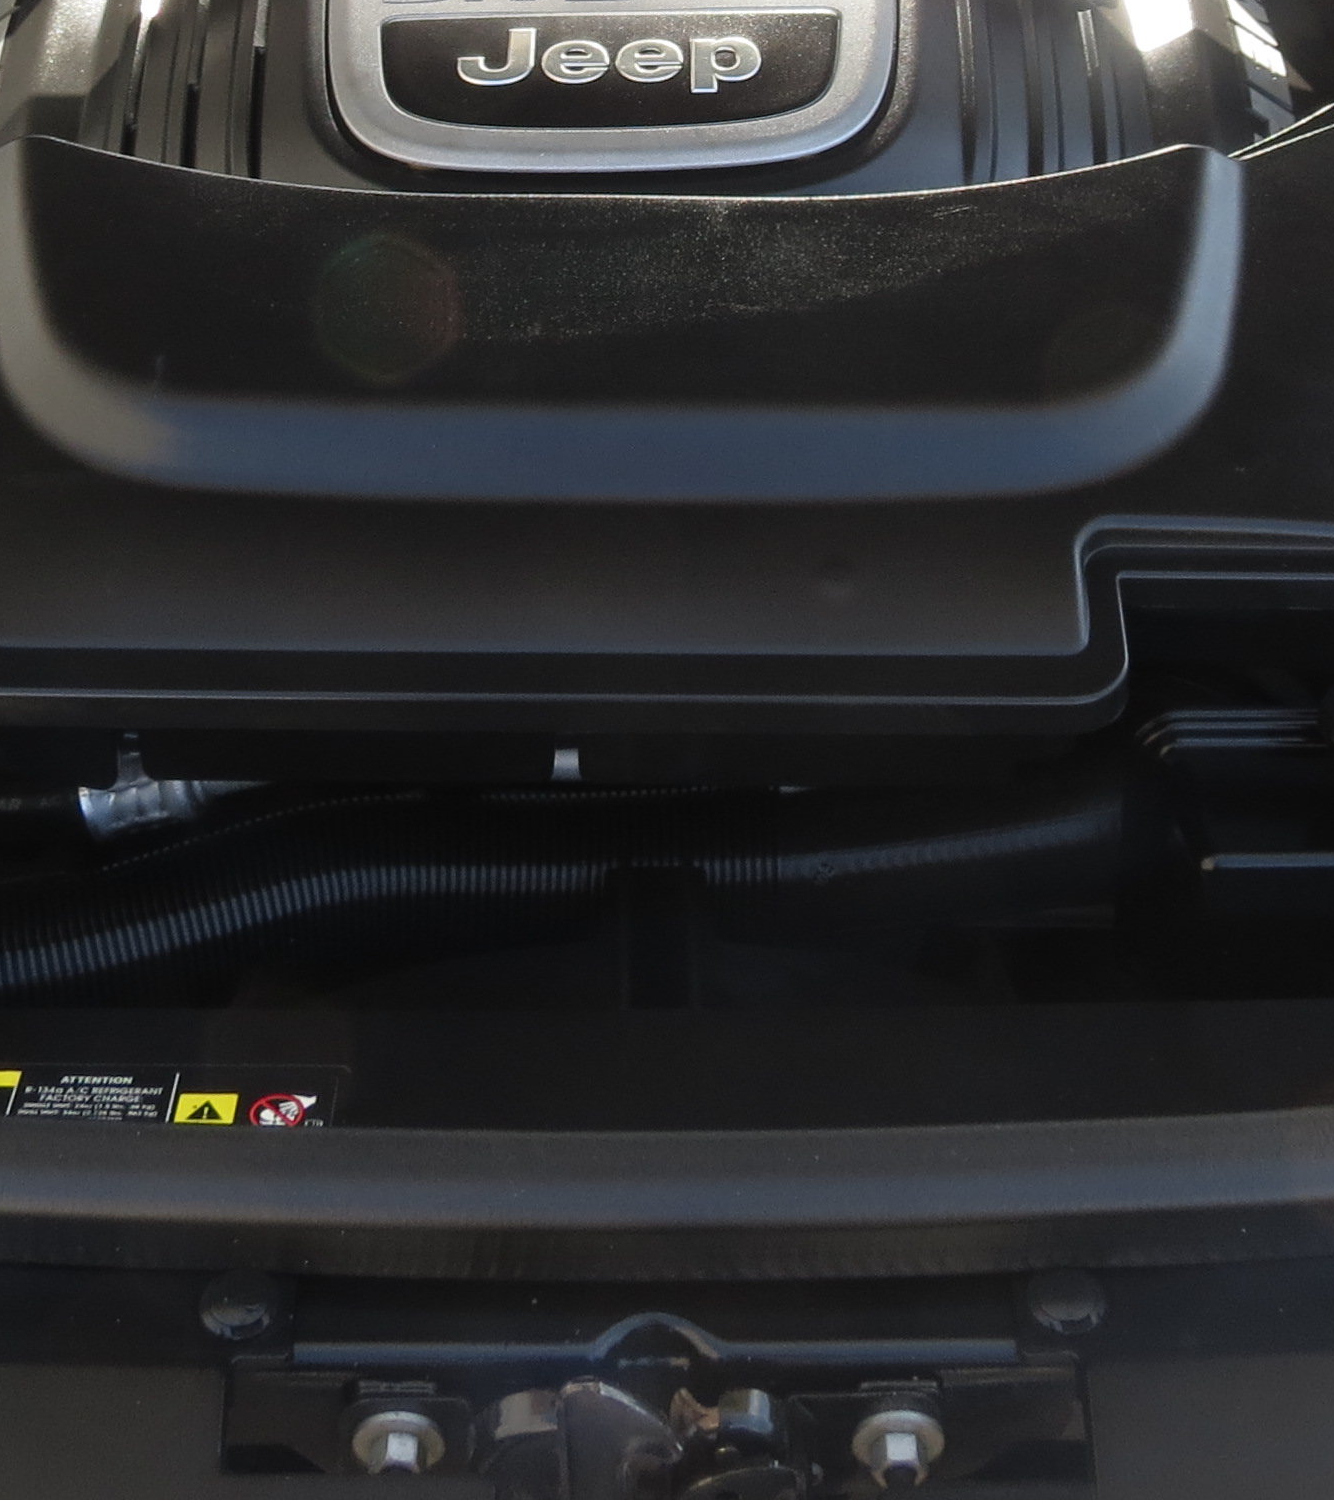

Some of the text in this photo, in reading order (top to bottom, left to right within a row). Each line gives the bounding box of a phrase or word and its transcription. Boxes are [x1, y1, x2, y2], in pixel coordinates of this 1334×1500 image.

[456, 26, 764, 94] Jeep
[60, 1075, 134, 1085] ATTENTION
[66, 1086, 89, 1096] A/C
[91, 1087, 164, 1096] REFRIGERANT
[39, 1094, 91, 1103] FACTORY
